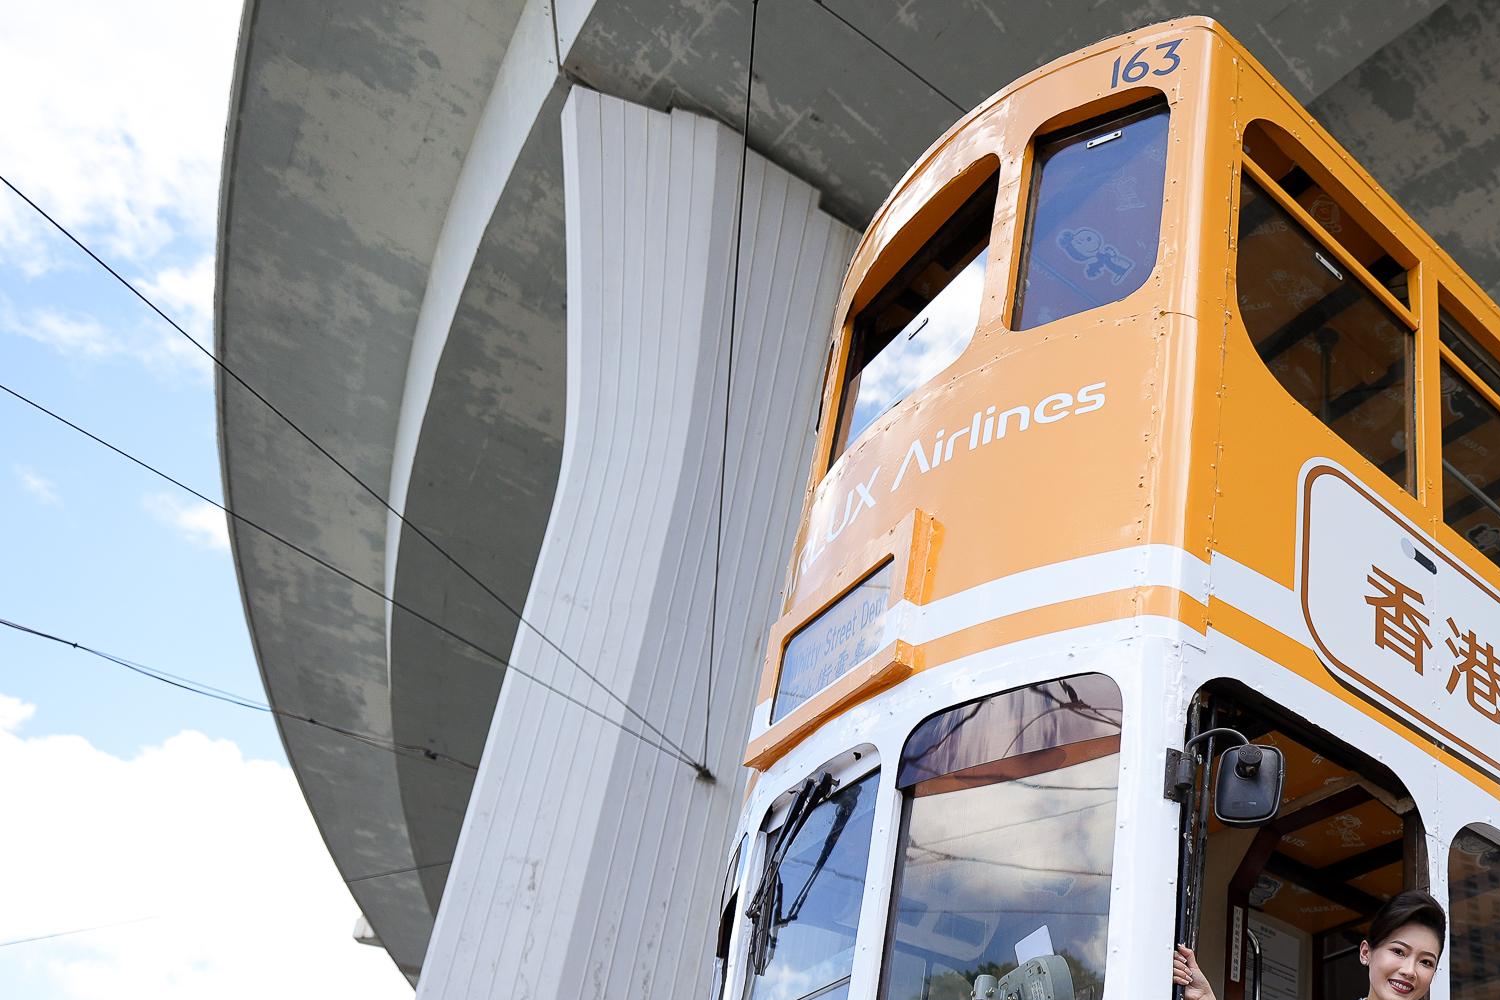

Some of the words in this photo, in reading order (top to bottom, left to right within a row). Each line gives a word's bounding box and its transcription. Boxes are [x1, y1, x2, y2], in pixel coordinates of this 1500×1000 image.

[1111, 38, 1183, 89] 163
[890, 381, 1106, 493] Airlines
[825, 615, 857, 655] Street
[860, 594, 888, 630] Dep
